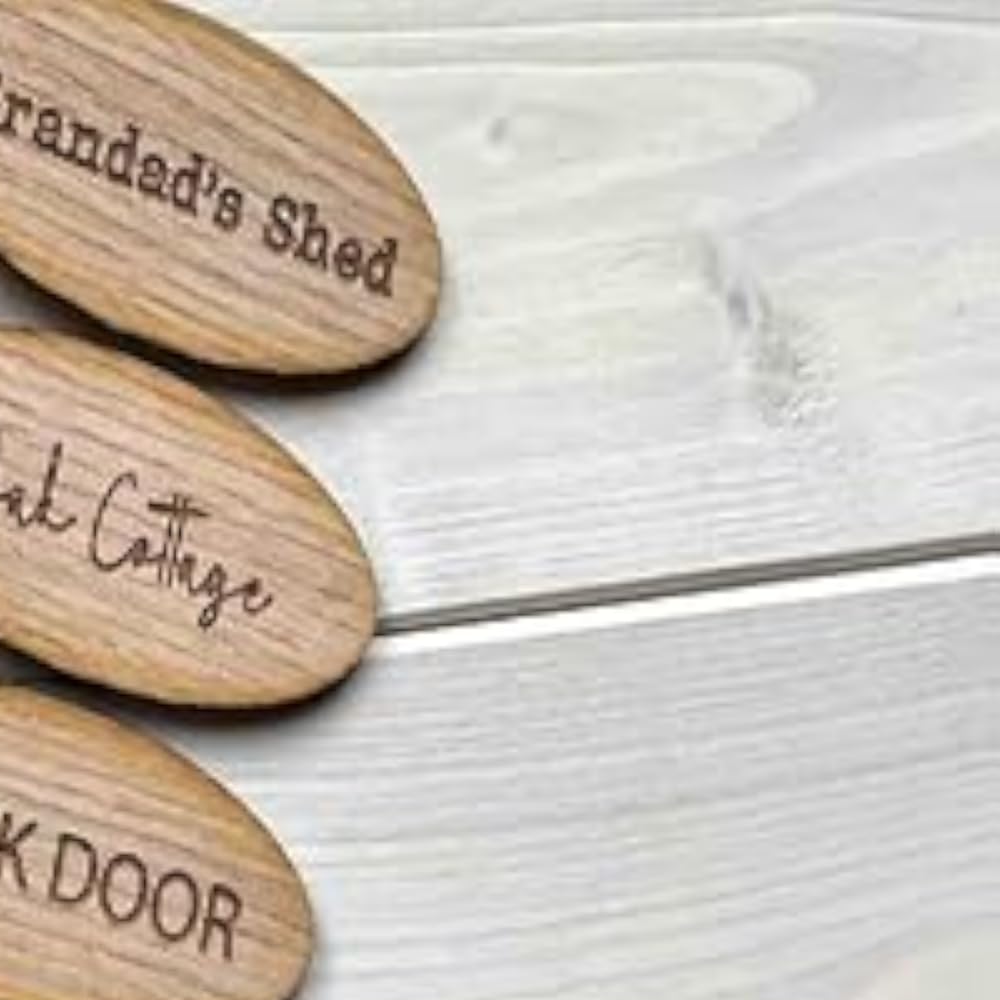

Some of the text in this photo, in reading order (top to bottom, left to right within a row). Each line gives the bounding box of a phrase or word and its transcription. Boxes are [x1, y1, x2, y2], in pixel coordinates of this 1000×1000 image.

[263, 194, 398, 296] Shed
[91, 472, 274, 630] Cottage
[49, 831, 243, 962] DOOR
